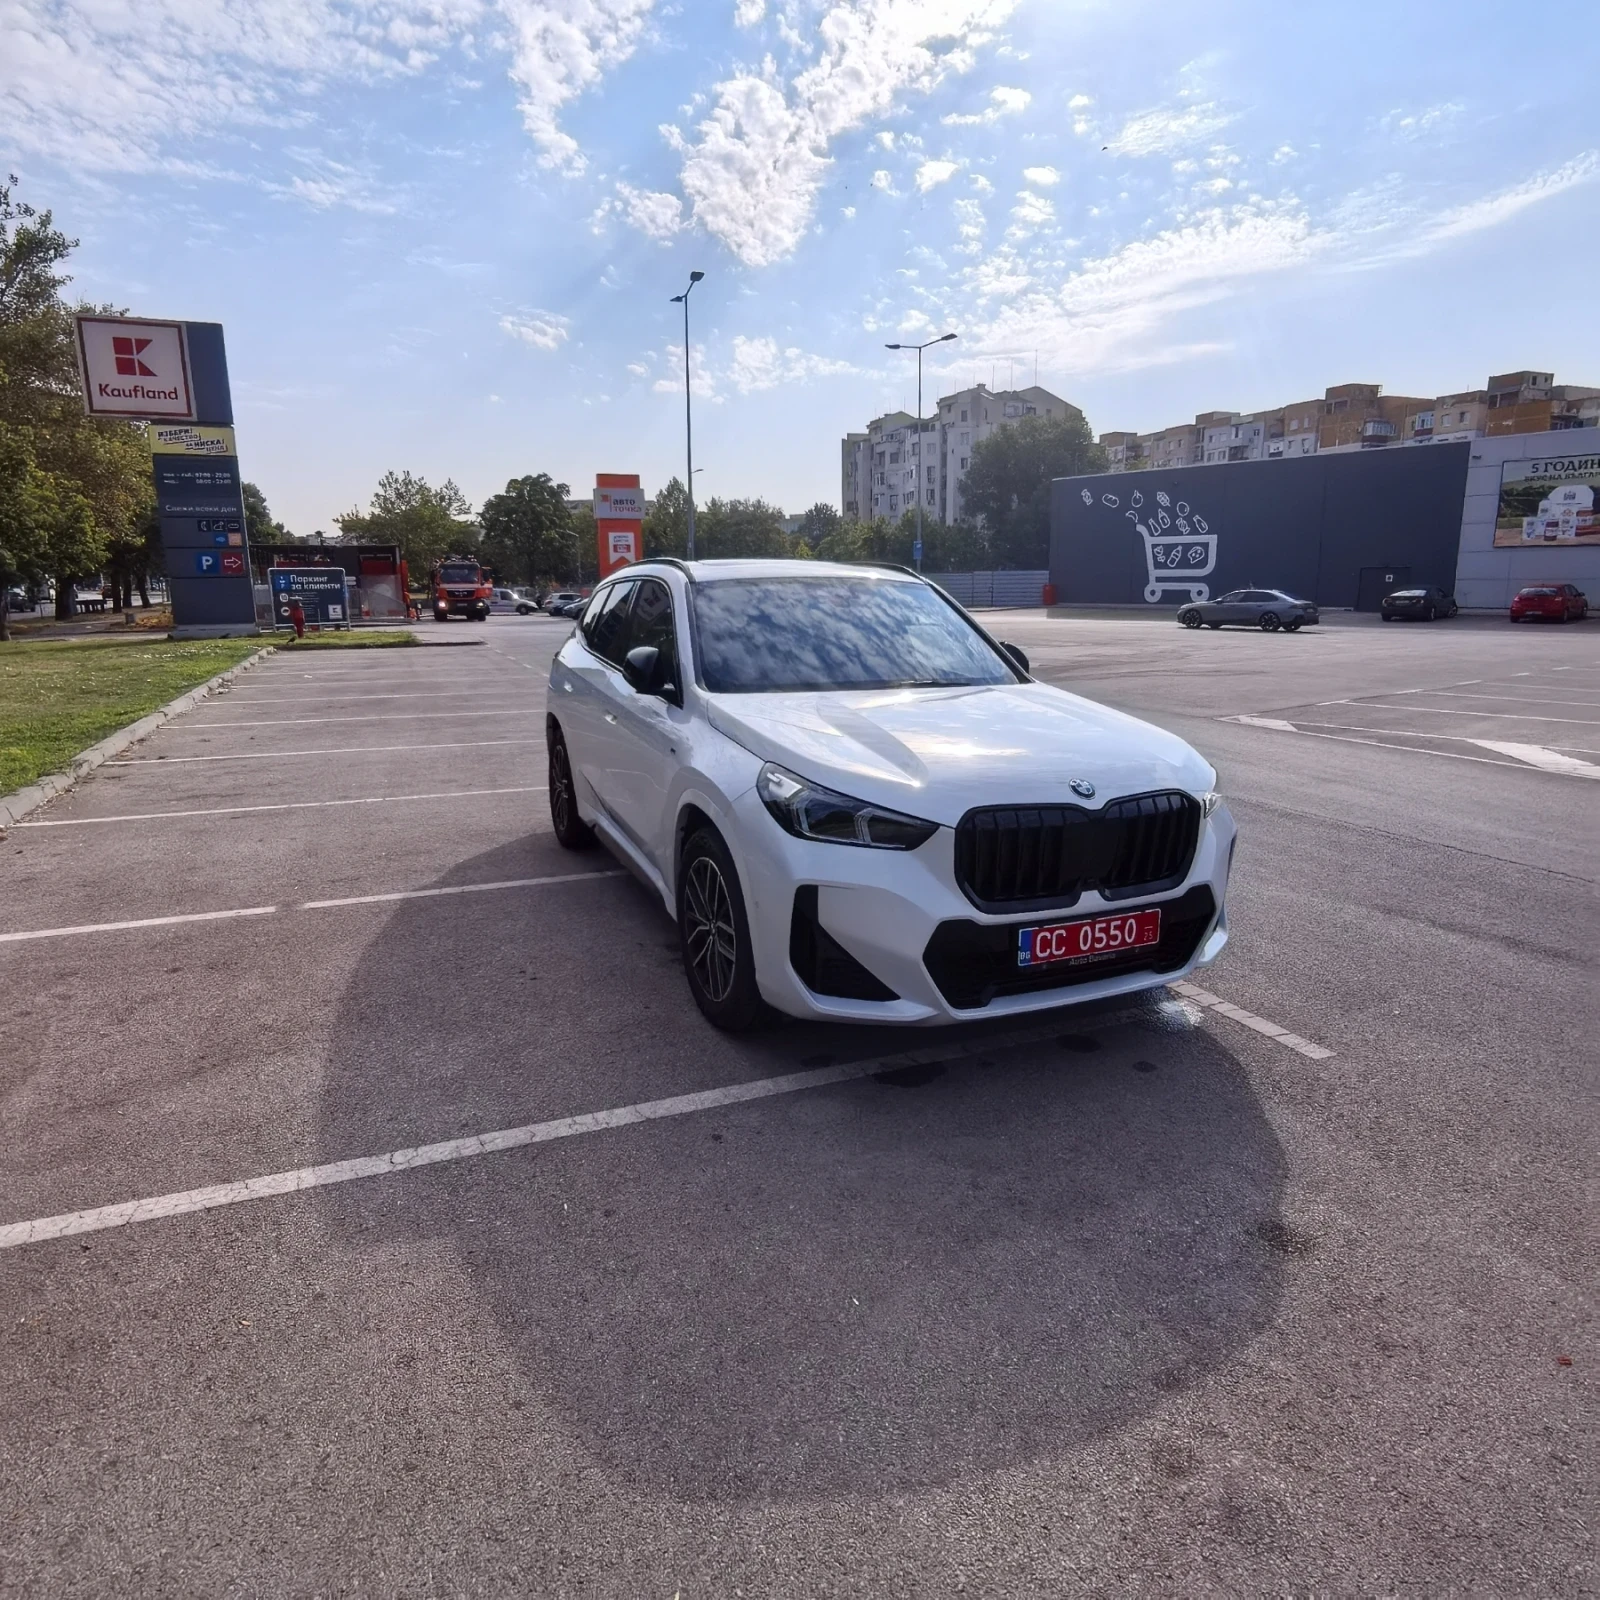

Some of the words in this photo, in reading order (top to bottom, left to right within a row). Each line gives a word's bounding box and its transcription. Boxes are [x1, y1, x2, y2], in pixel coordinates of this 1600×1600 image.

[98, 383, 179, 401] Kaufland
[1531, 463, 1540, 474] 5
[1079, 918, 1137, 951] 0550
[1020, 951, 1031, 960] BG
